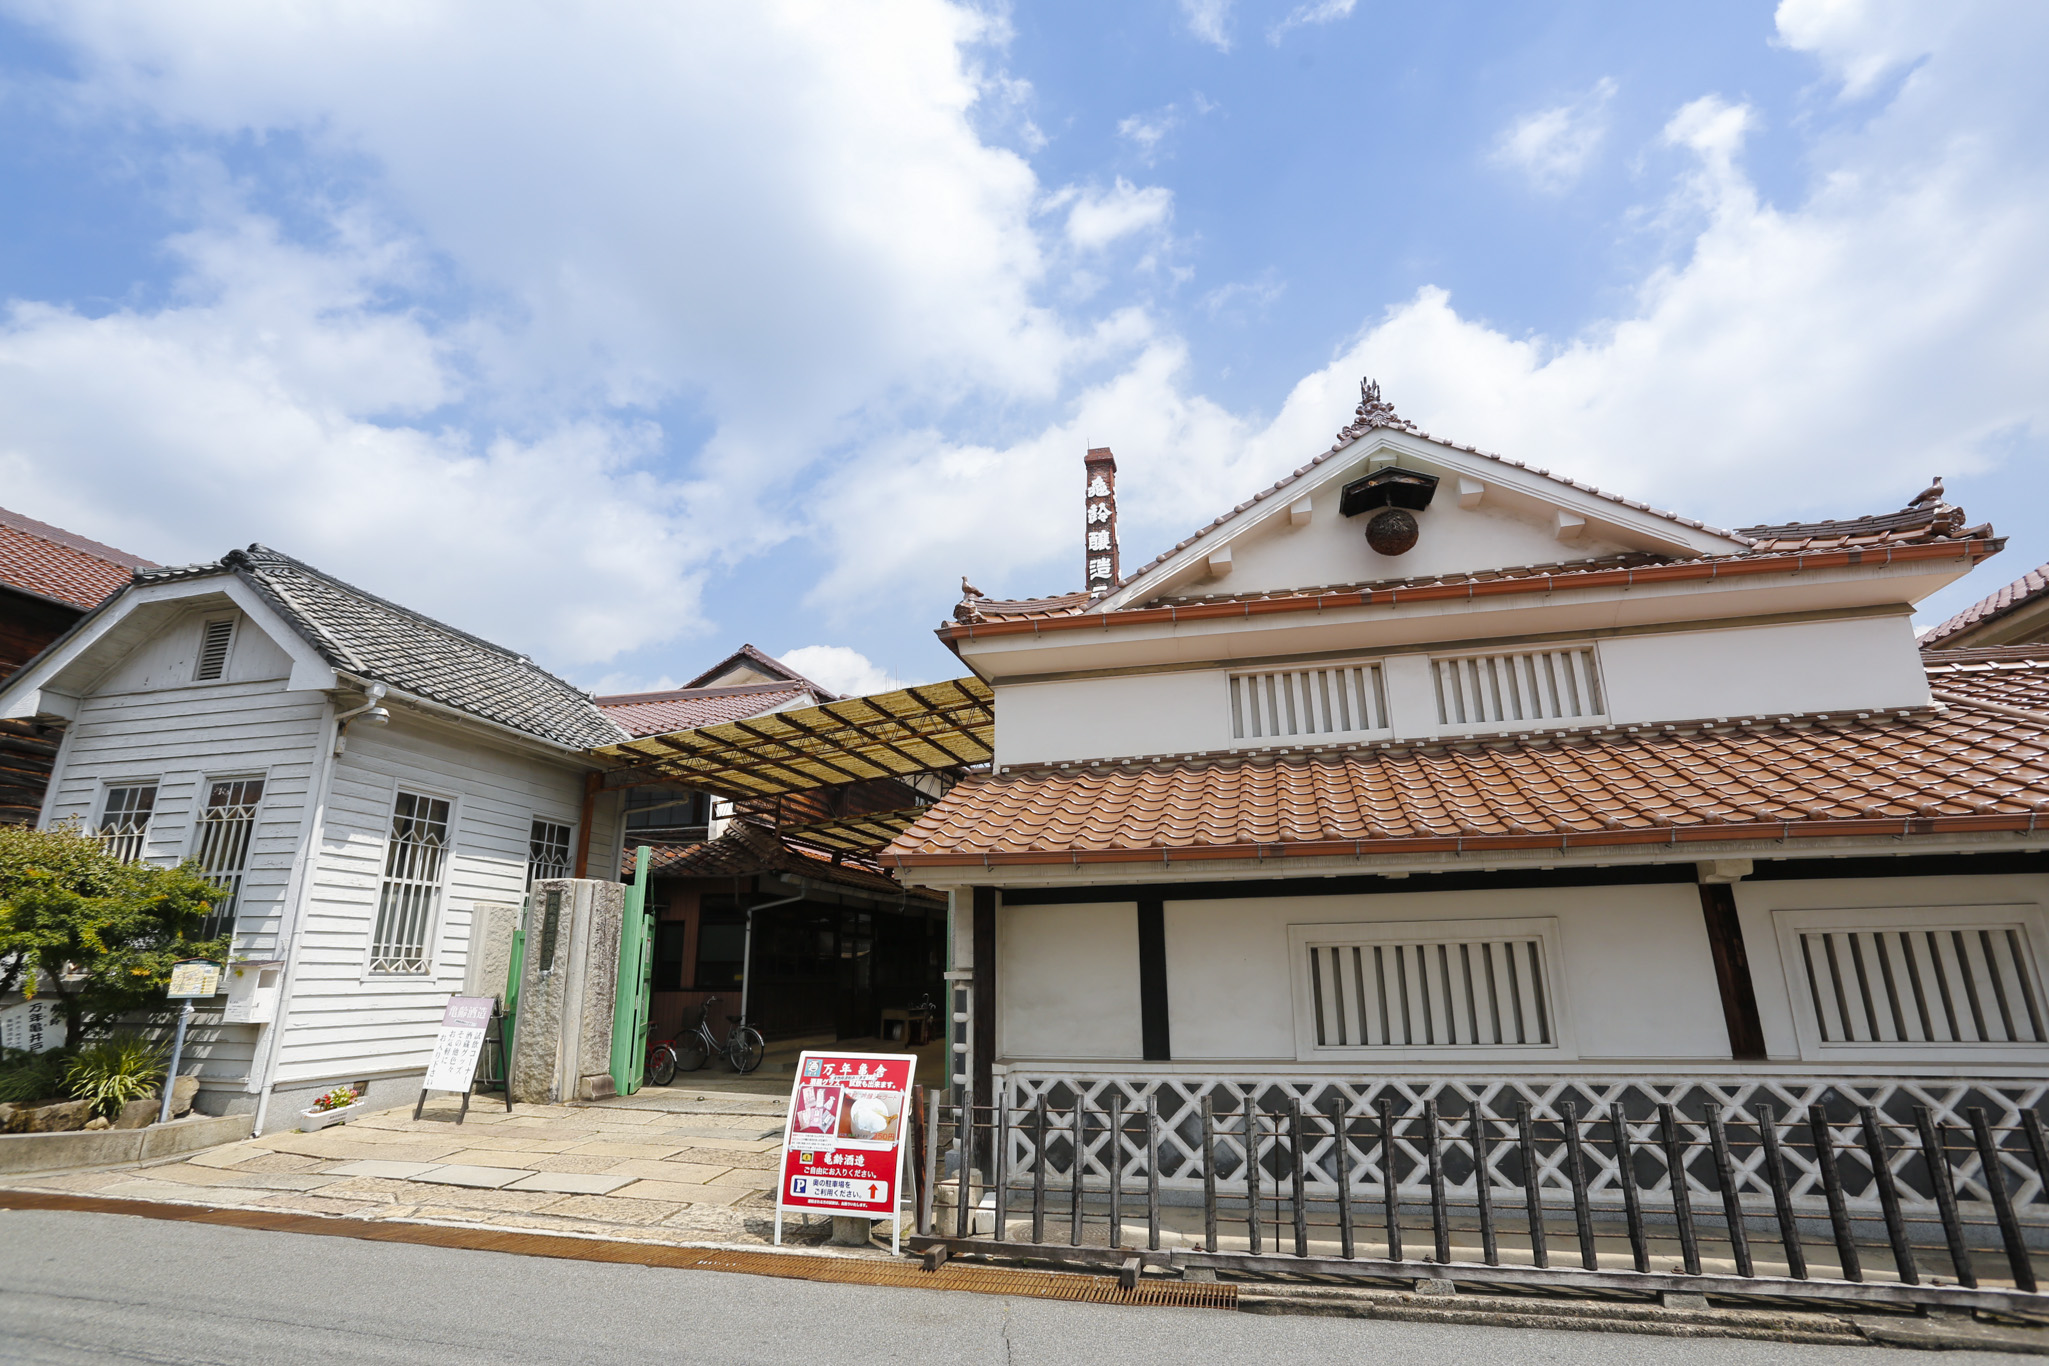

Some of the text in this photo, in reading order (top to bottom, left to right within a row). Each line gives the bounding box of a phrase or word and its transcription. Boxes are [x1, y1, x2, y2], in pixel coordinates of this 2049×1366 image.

[448, 1005, 488, 1019] 亀齢酒造
[441, 1029, 456, 1065] お気軽に
[448, 1030, 465, 1073] その他色々
[455, 1031, 473, 1075] 酒蔵グッズ
[426, 1034, 447, 1086] お入り下さい
[463, 1031, 482, 1085] 試飲コーナー
[823, 1152, 866, 1167] 亀齢酒造
[803, 1166, 877, 1179] ご自由にお入りください。
[795, 1179, 806, 1192] P
[812, 1179, 851, 1189] 奥の駐車場を
[814, 1188, 862, 1199] ご利用ください。
